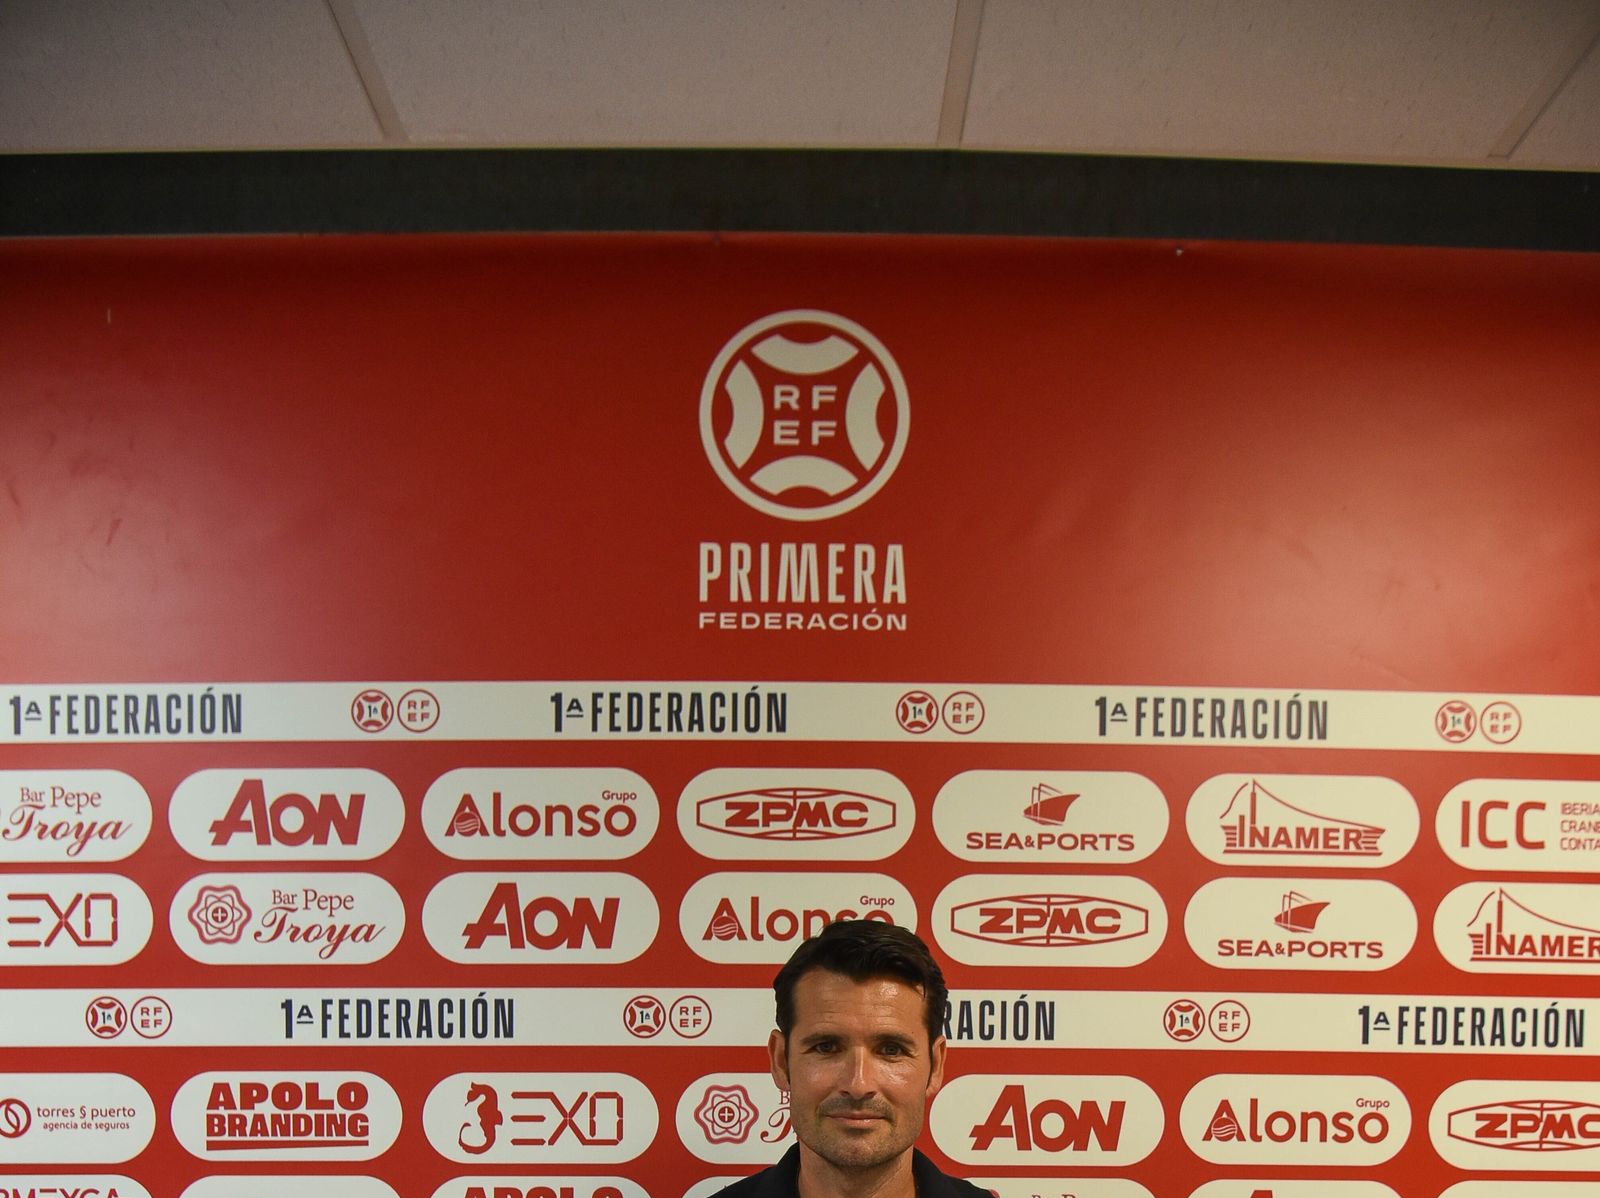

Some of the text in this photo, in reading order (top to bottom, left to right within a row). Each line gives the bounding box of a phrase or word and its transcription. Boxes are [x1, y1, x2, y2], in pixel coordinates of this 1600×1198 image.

[700, 543, 906, 603] PRIMERA
[699, 608, 906, 630] FEDERACIÓN
[50, 687, 241, 734] FEDERACIÓN
[592, 686, 786, 733] FEDERACIÓN
[1136, 693, 1327, 740] FEDERACIÓN
[21, 786, 101, 814] Bar Pepe
[602, 790, 637, 803] Grupo
[445, 793, 637, 837] Alonso
[725, 802, 869, 828] ZPMC
[1461, 801, 1546, 849] ICC
[2, 804, 133, 857] Troya
[967, 832, 1134, 851] SEA&PORTS
[1239, 815, 1363, 851] INAMER
[273, 889, 354, 917] Bar Pepe
[860, 896, 894, 908] Grupo
[253, 906, 386, 959] Troya
[979, 907, 1121, 934] ZPMC
[1218, 939, 1383, 958] SEA&PORTS
[322, 992, 513, 1038] FEDERACIÓN
[942, 995, 1055, 1041] RACIÓN
[1398, 1002, 1584, 1047] FEDERACIÓN
[207, 1082, 368, 1111] APOLO
[1356, 1098, 1390, 1111] Grupo
[37, 1107, 75, 1117] torres
[91, 1107, 135, 1120] puerto
[43, 1121, 129, 1132] agencia de seguros
[206, 1113, 369, 1137] BRANDING
[1202, 1098, 1390, 1143] Alonso
